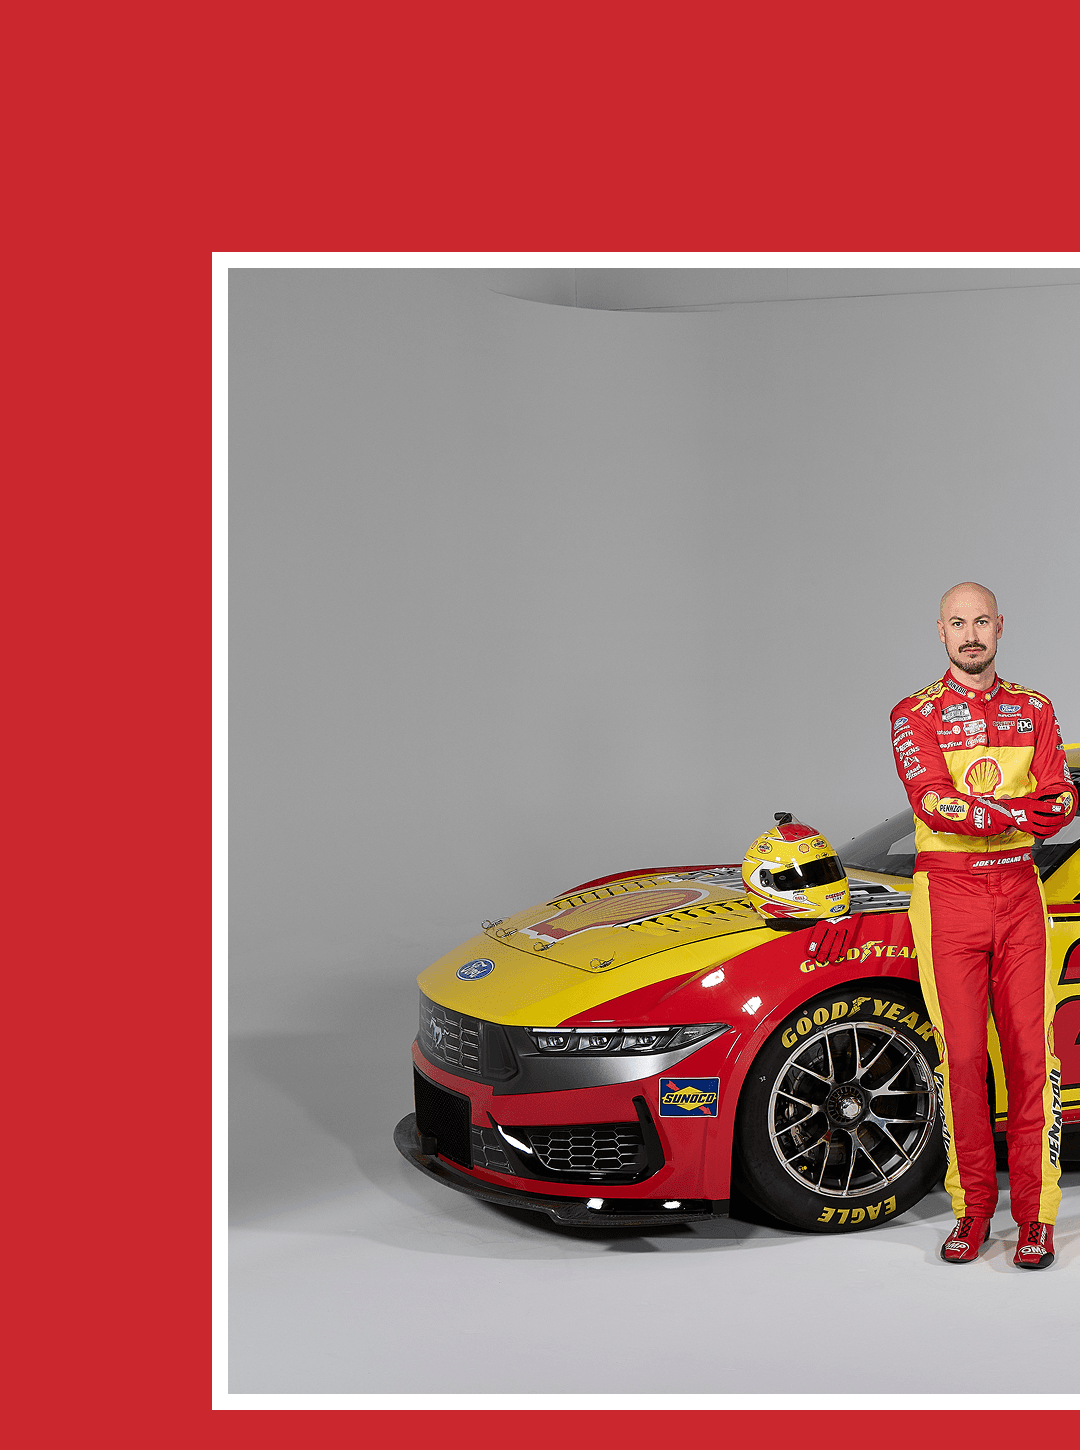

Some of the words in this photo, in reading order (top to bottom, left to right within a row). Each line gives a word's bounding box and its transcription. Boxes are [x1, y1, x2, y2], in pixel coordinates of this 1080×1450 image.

[972, 859, 996, 867] JOEY
[997, 856, 1021, 864] LOGANO
[663, 1092, 718, 1106] SUNOCO
[817, 1195, 897, 1225] EAGLE
